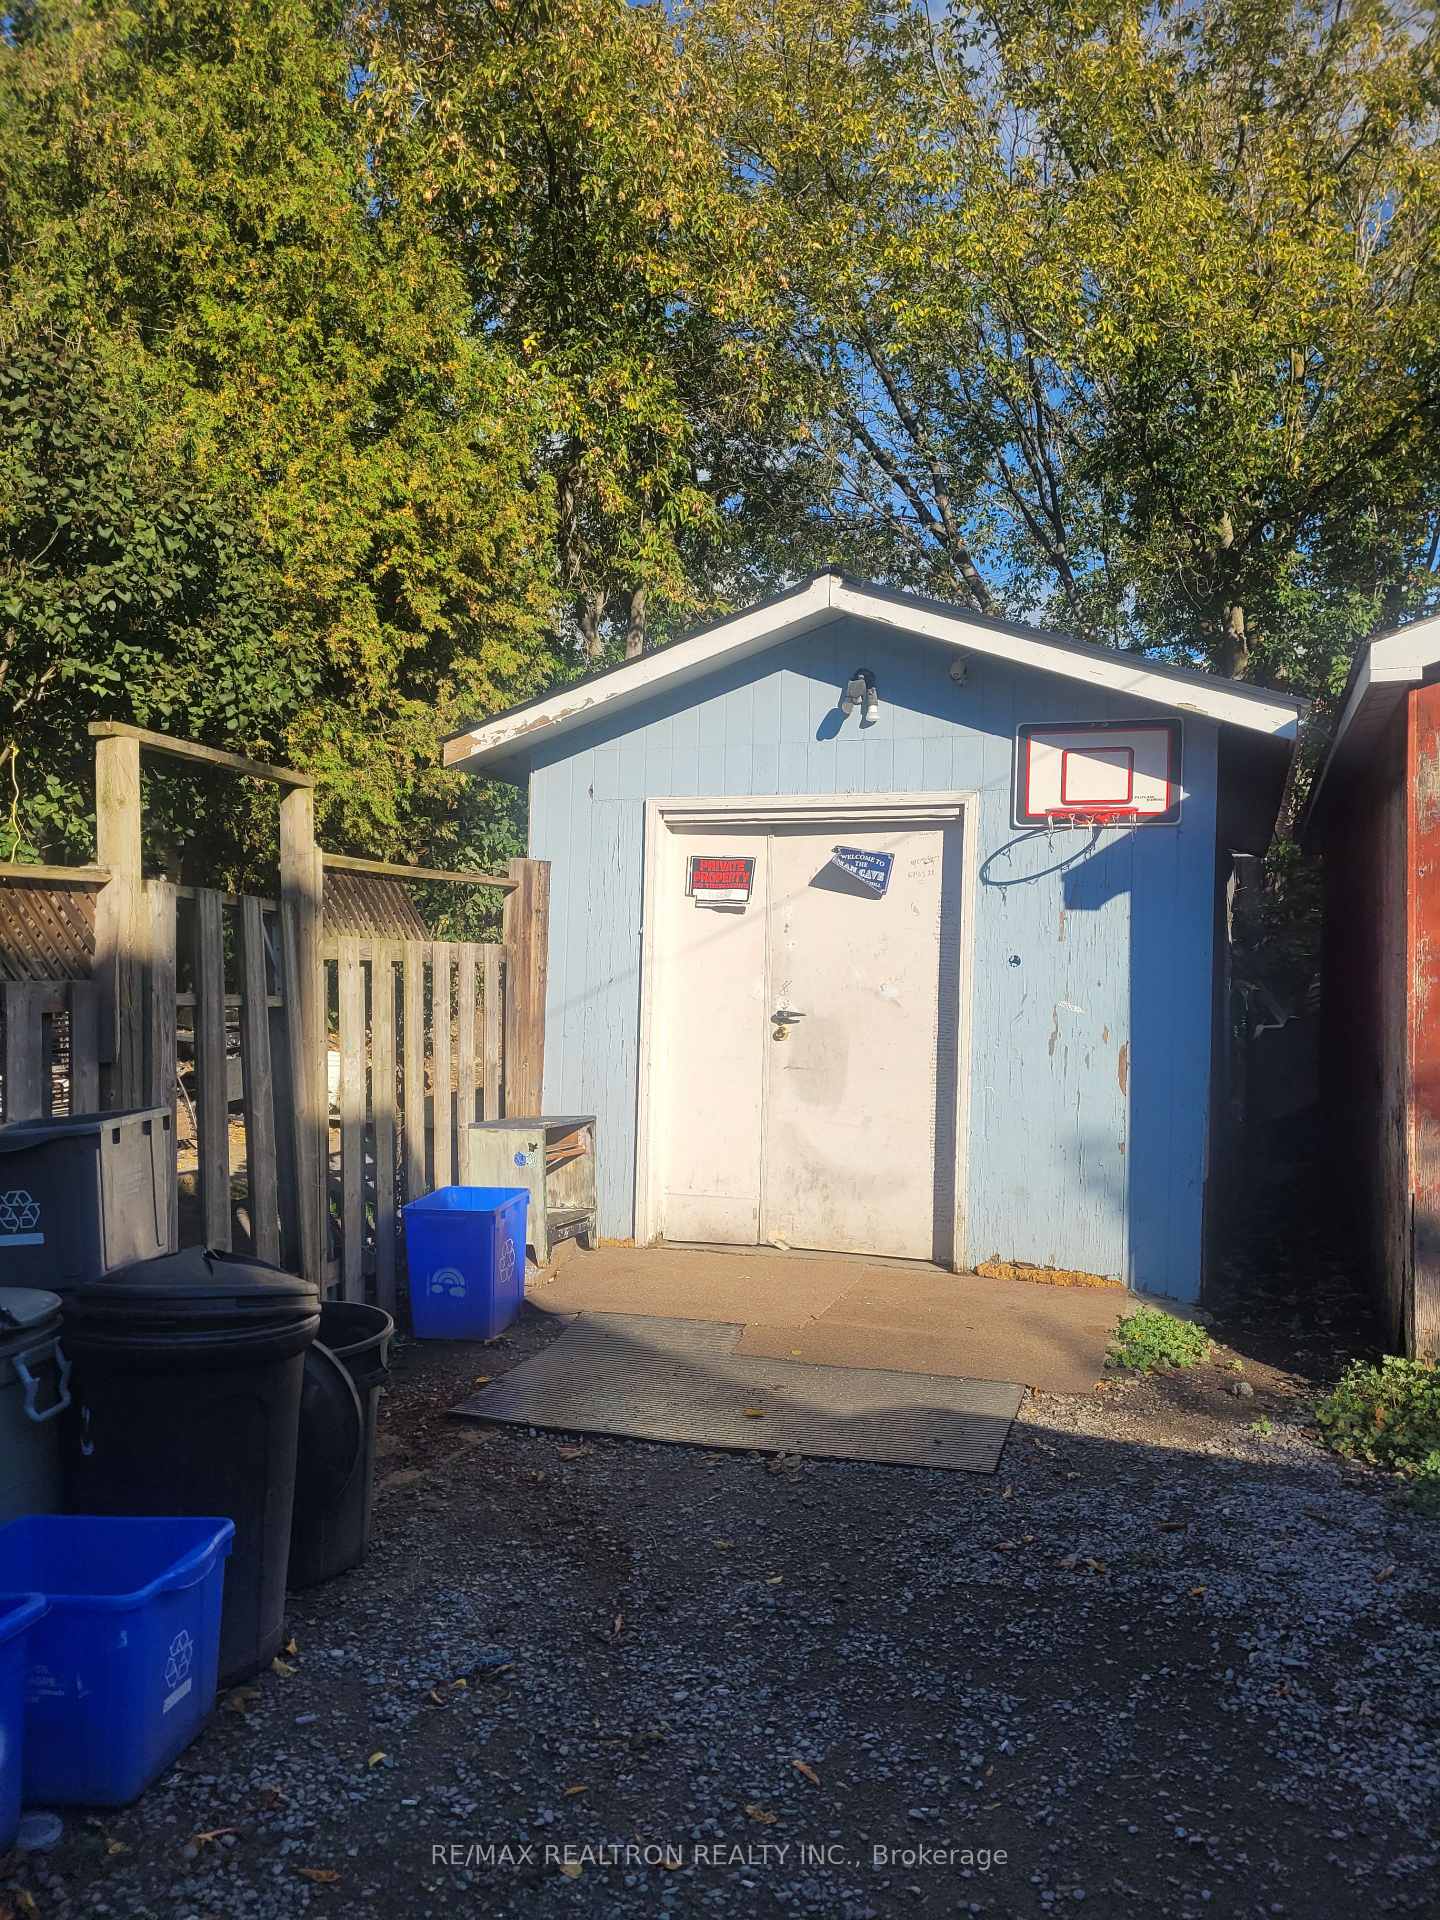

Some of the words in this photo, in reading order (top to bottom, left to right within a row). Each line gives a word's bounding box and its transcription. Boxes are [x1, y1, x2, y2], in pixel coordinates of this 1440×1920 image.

[699, 860, 746, 871] PRIVATE
[841, 854, 875, 862] WELCOME
[876, 858, 885, 867] TO
[693, 871, 750, 882] PROPERTY
[838, 860, 857, 873] MAN
[858, 869, 885, 882] CAVE
